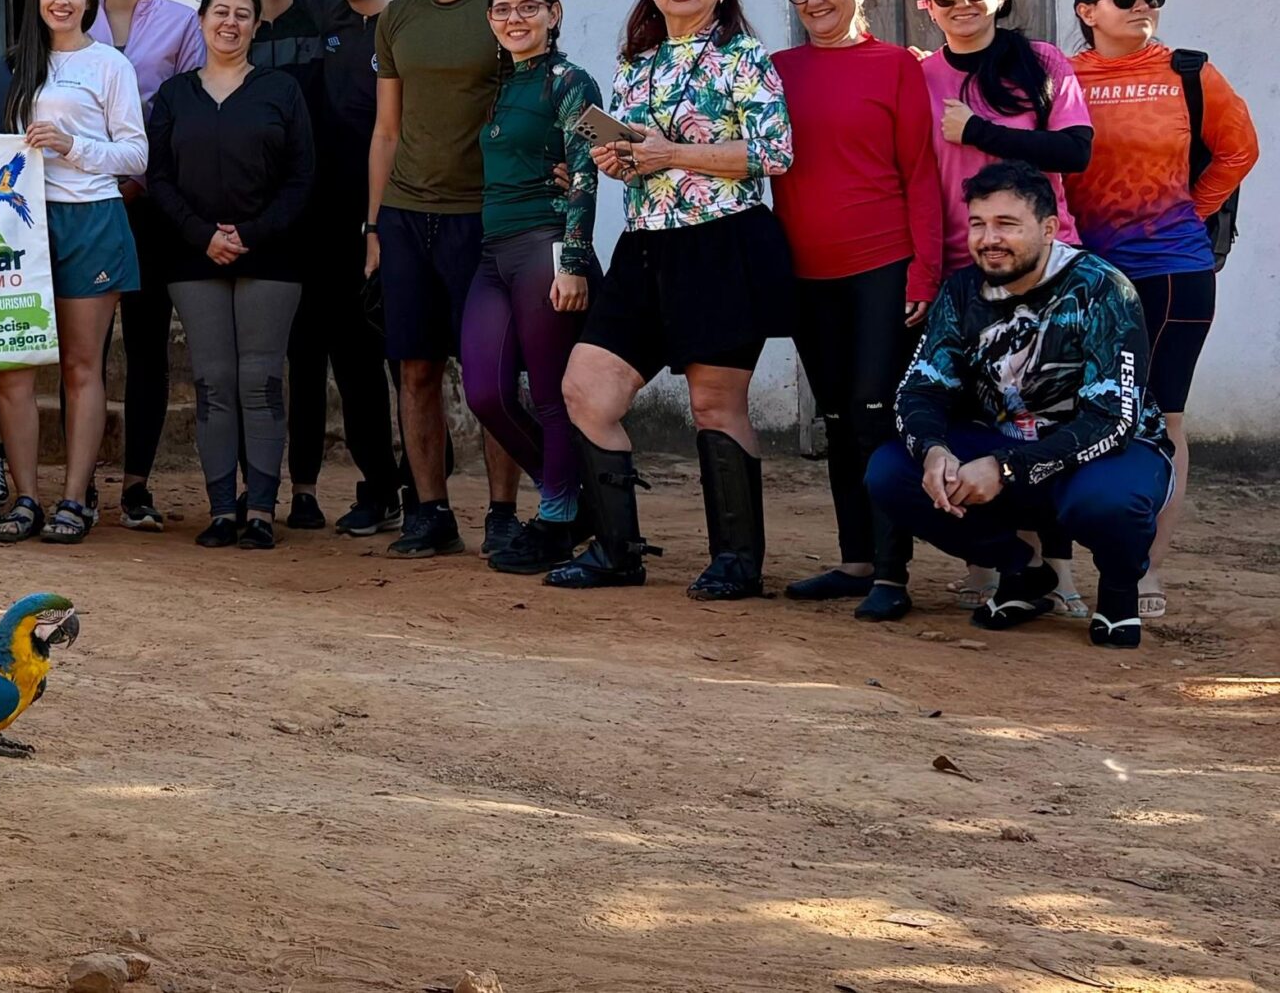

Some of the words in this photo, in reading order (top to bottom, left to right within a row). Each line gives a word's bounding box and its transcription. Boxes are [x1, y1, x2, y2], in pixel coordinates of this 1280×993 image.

[1090, 86, 1121, 99] MAR
[1125, 84, 1180, 98] NEGRO
[8, 334, 47, 350] agora
